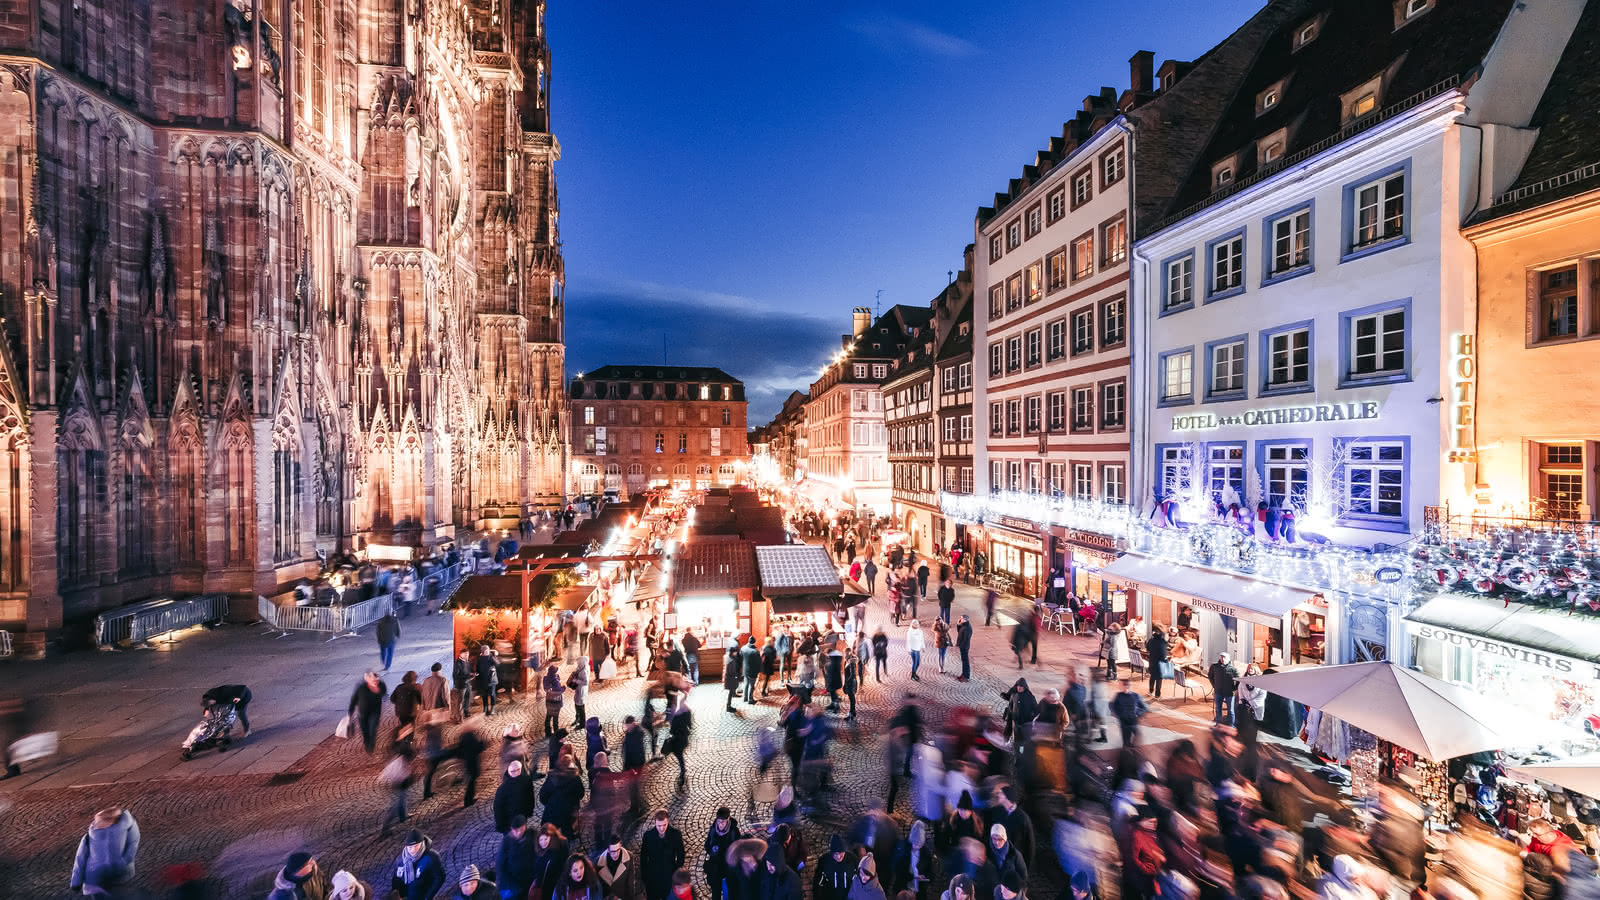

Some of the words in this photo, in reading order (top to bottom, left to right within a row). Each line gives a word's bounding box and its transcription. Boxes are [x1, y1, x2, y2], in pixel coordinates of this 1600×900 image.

[1455, 334, 1473, 448] HOTEL
[1171, 414, 1217, 430] HOTEL
[1243, 402, 1378, 425] CATHEDRALE
[1079, 534, 1117, 549] CIGOGNE
[1124, 581, 1140, 590] CAFE
[1191, 598, 1236, 616] BRASSERIE
[1419, 626, 1573, 673] SOUVENIRS
